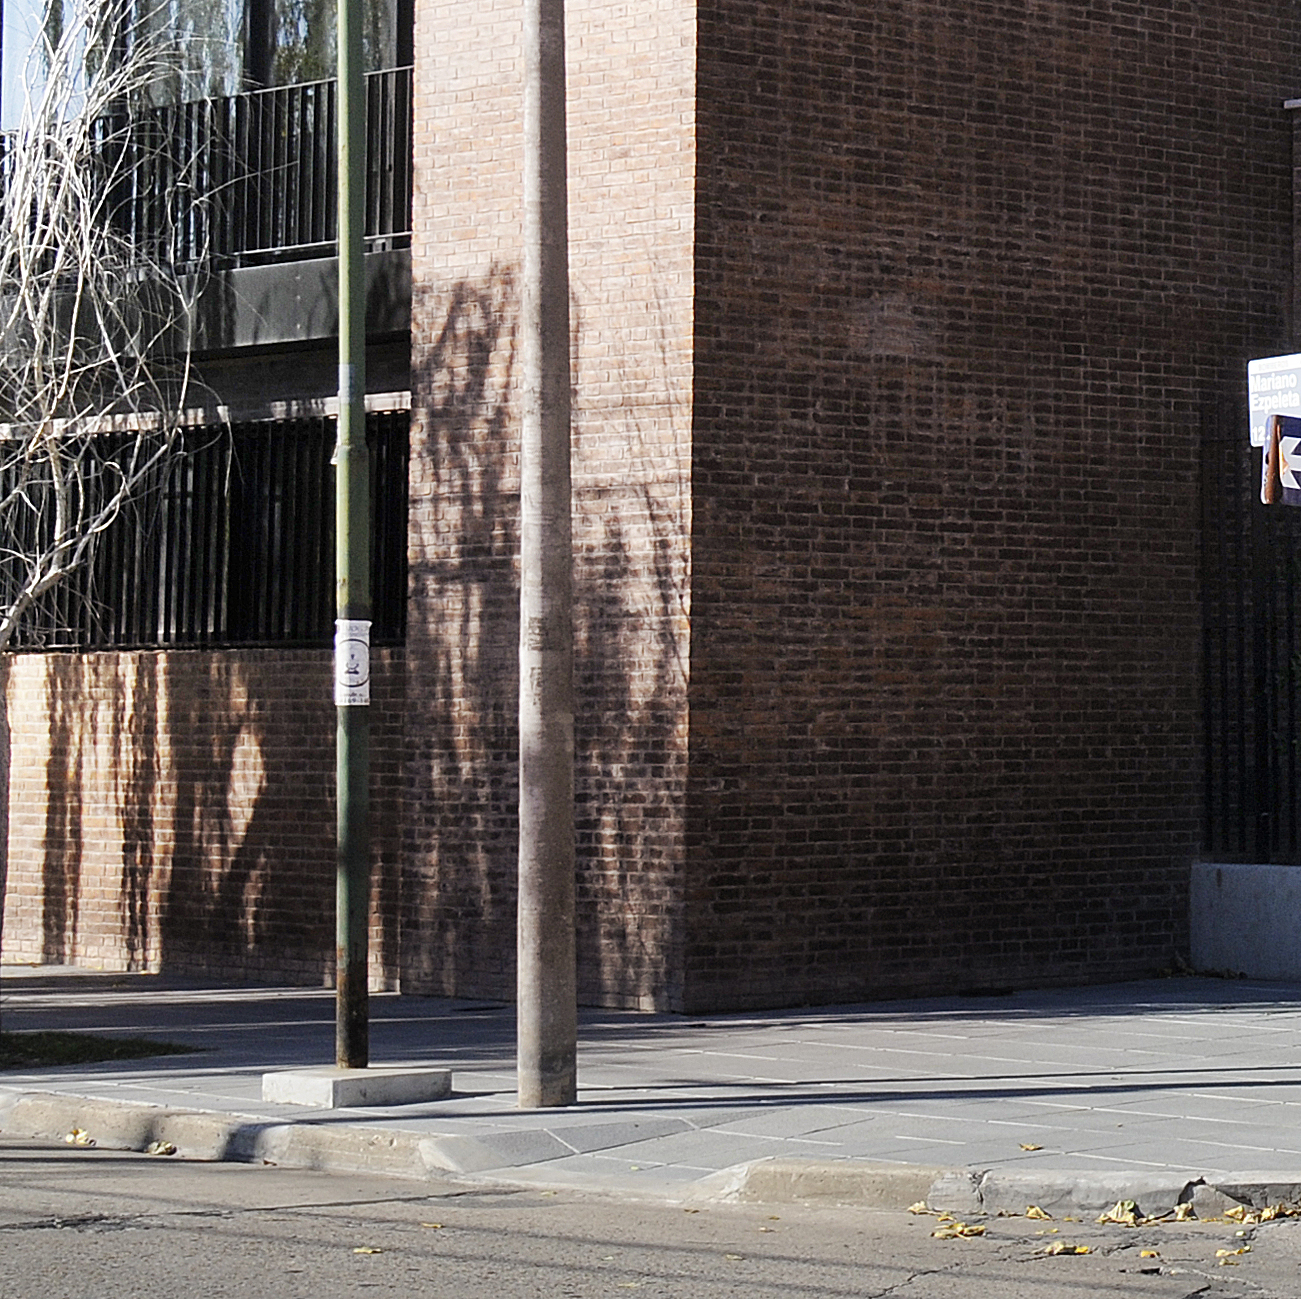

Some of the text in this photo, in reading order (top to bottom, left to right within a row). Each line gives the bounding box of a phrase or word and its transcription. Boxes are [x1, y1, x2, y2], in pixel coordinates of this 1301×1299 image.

[1251, 373, 1297, 392] Mariano
[1251, 391, 1300, 414] Ezpeleta
[1252, 425, 1266, 442] 12
